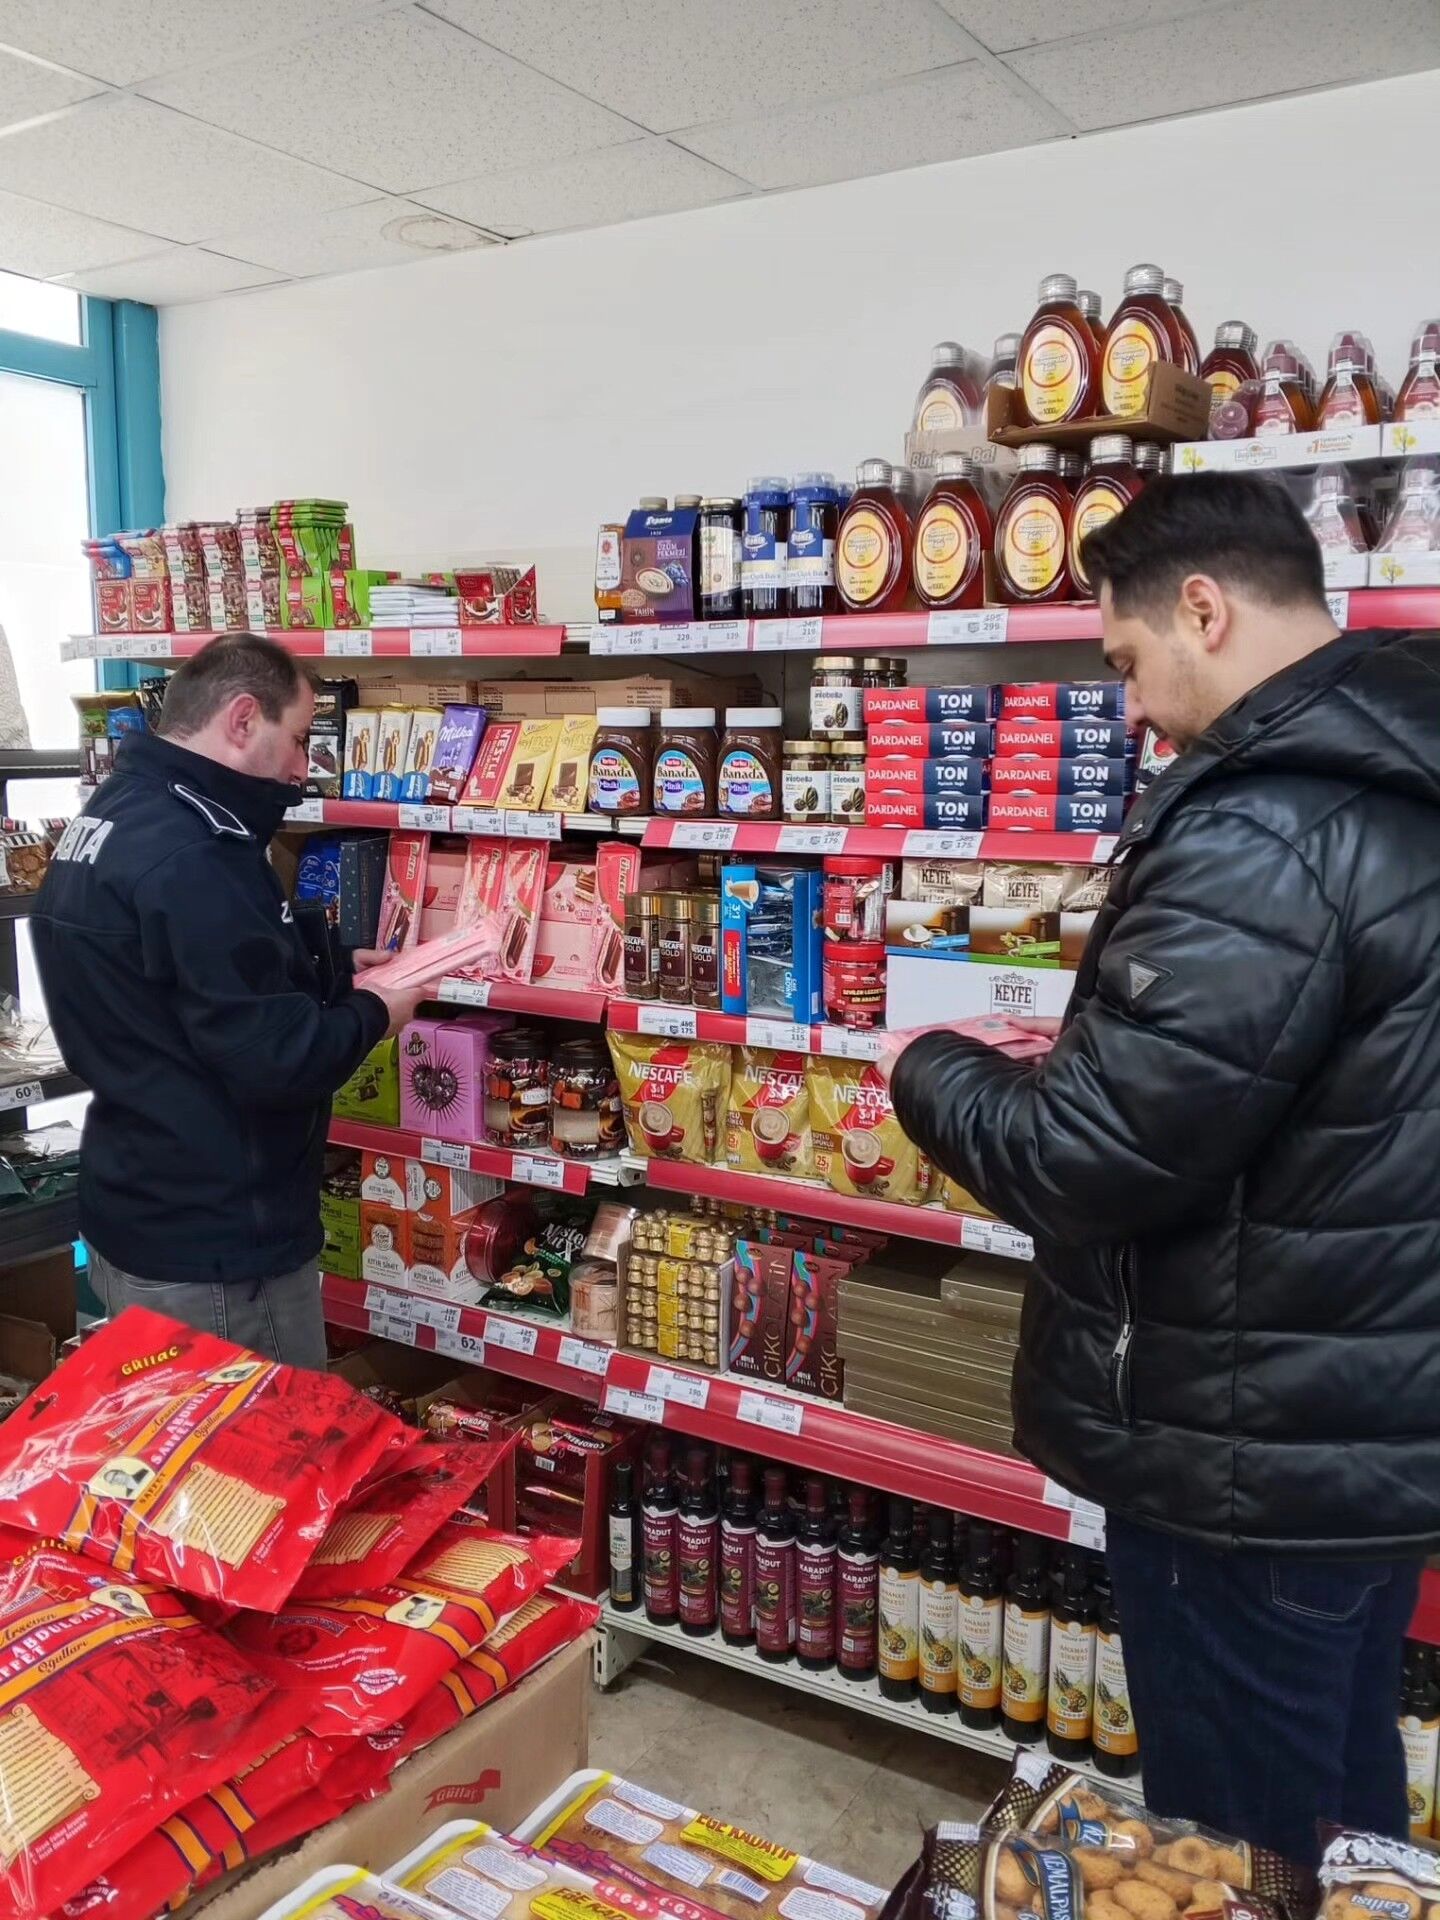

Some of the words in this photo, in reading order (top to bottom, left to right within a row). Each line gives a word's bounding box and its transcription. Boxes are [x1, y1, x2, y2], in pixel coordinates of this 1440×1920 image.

[938, 694, 973, 708] TON
[1004, 695, 1051, 707] DARDANEL
[1068, 690, 1104, 705] TON
[867, 699, 920, 711] DARDANEL
[440, 725, 474, 742] Milka
[941, 731, 976, 745] TON
[999, 733, 1055, 744] DARDANEL
[1074, 728, 1111, 743] TON
[871, 735, 924, 746] DARDANEL
[592, 765, 631, 777] Banada
[657, 766, 696, 778] Banada
[722, 767, 764, 779] Banada
[867, 769, 918, 781] DARDANEL
[935, 766, 968, 781] TON
[995, 769, 1052, 781] DARDANEL
[1071, 766, 1109, 780] TON
[867, 804, 919, 816] DARDANEL
[935, 801, 969, 816] TON
[991, 805, 1049, 818] DARDANEL
[1069, 803, 1107, 818] TON
[921, 868, 951, 885] KEYFE
[1008, 882, 1040, 898] KEYFE
[995, 983, 1032, 1004] KEYFE
[15, 1086, 31, 1099] 60
[1011, 1240, 1027, 1249] 149
[461, 1336, 476, 1350] 62
[799, 1563, 834, 1575] KARADUT
[842, 1572, 878, 1583] KARADUT
